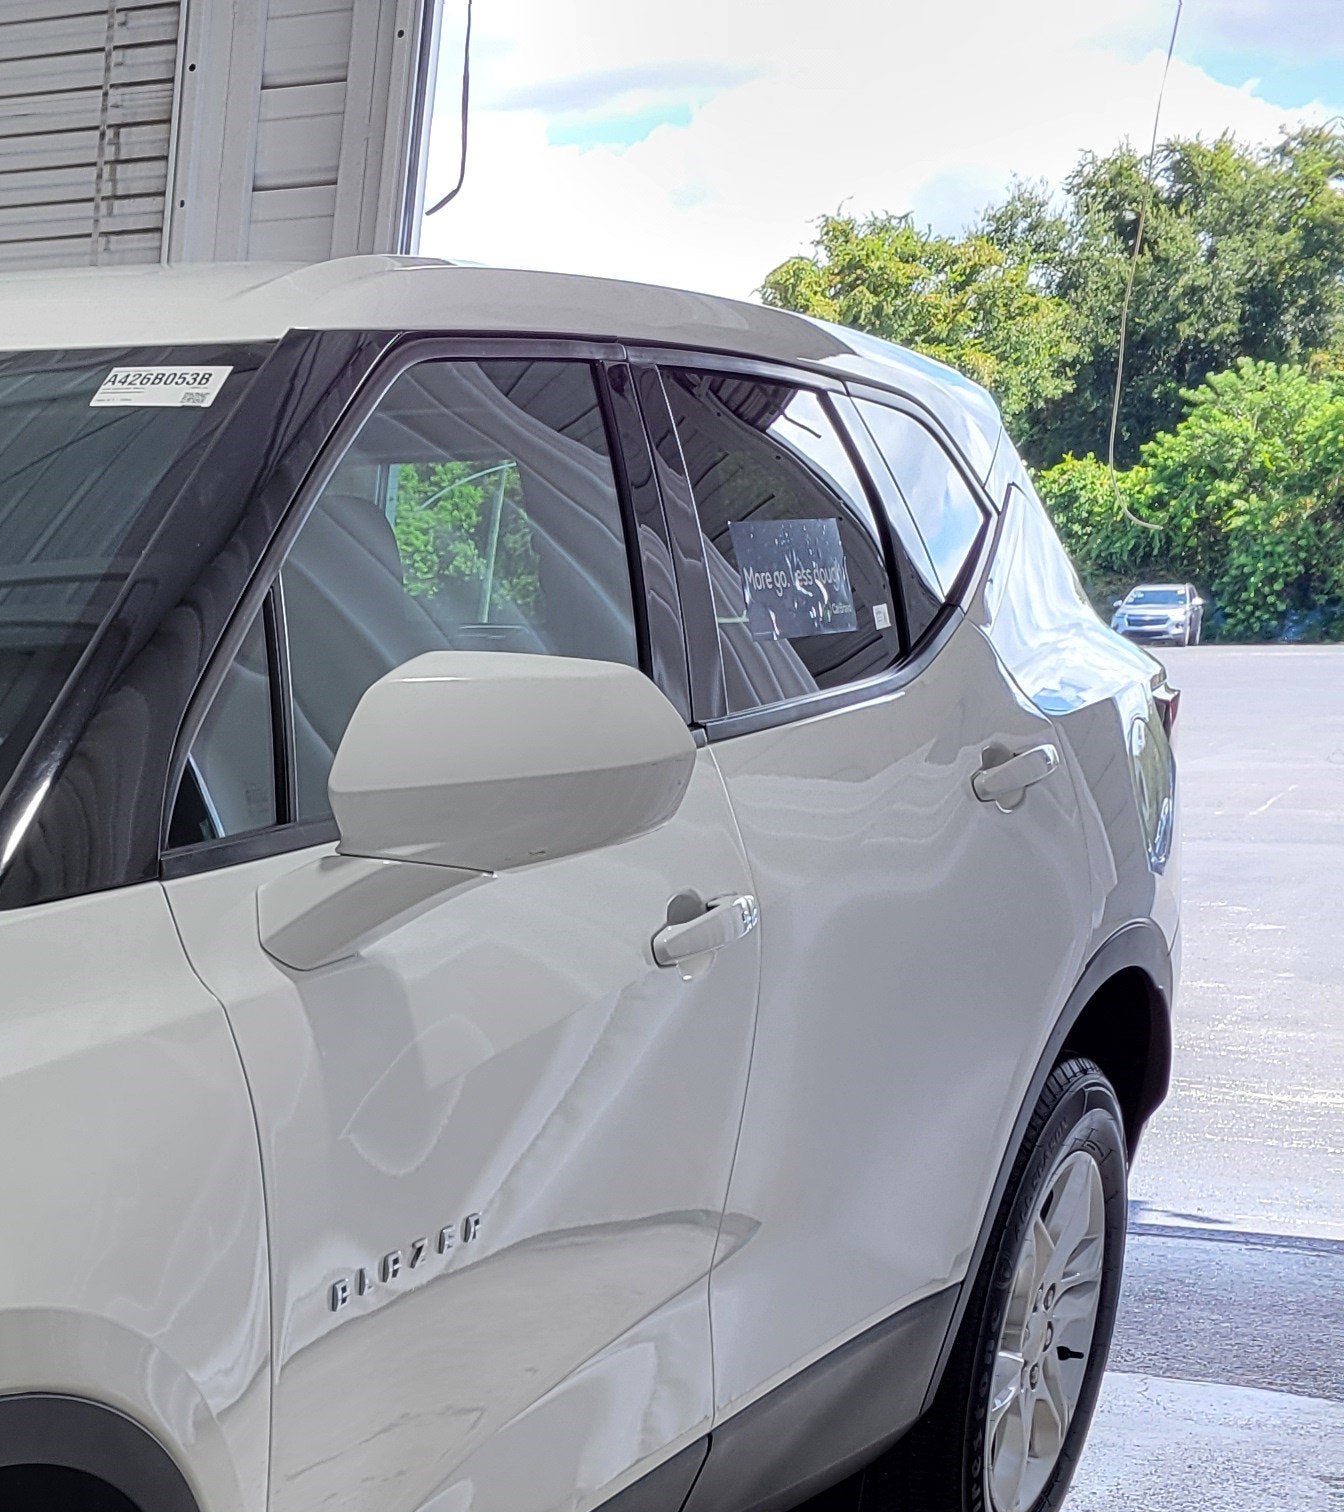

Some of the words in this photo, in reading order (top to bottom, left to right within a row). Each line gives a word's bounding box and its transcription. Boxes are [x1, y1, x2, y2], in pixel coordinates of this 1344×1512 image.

[103, 372, 213, 387] A426B053B
[743, 566, 773, 591] More
[773, 570, 791, 598] go.
[330, 1211, 483, 1313] BLAZER
